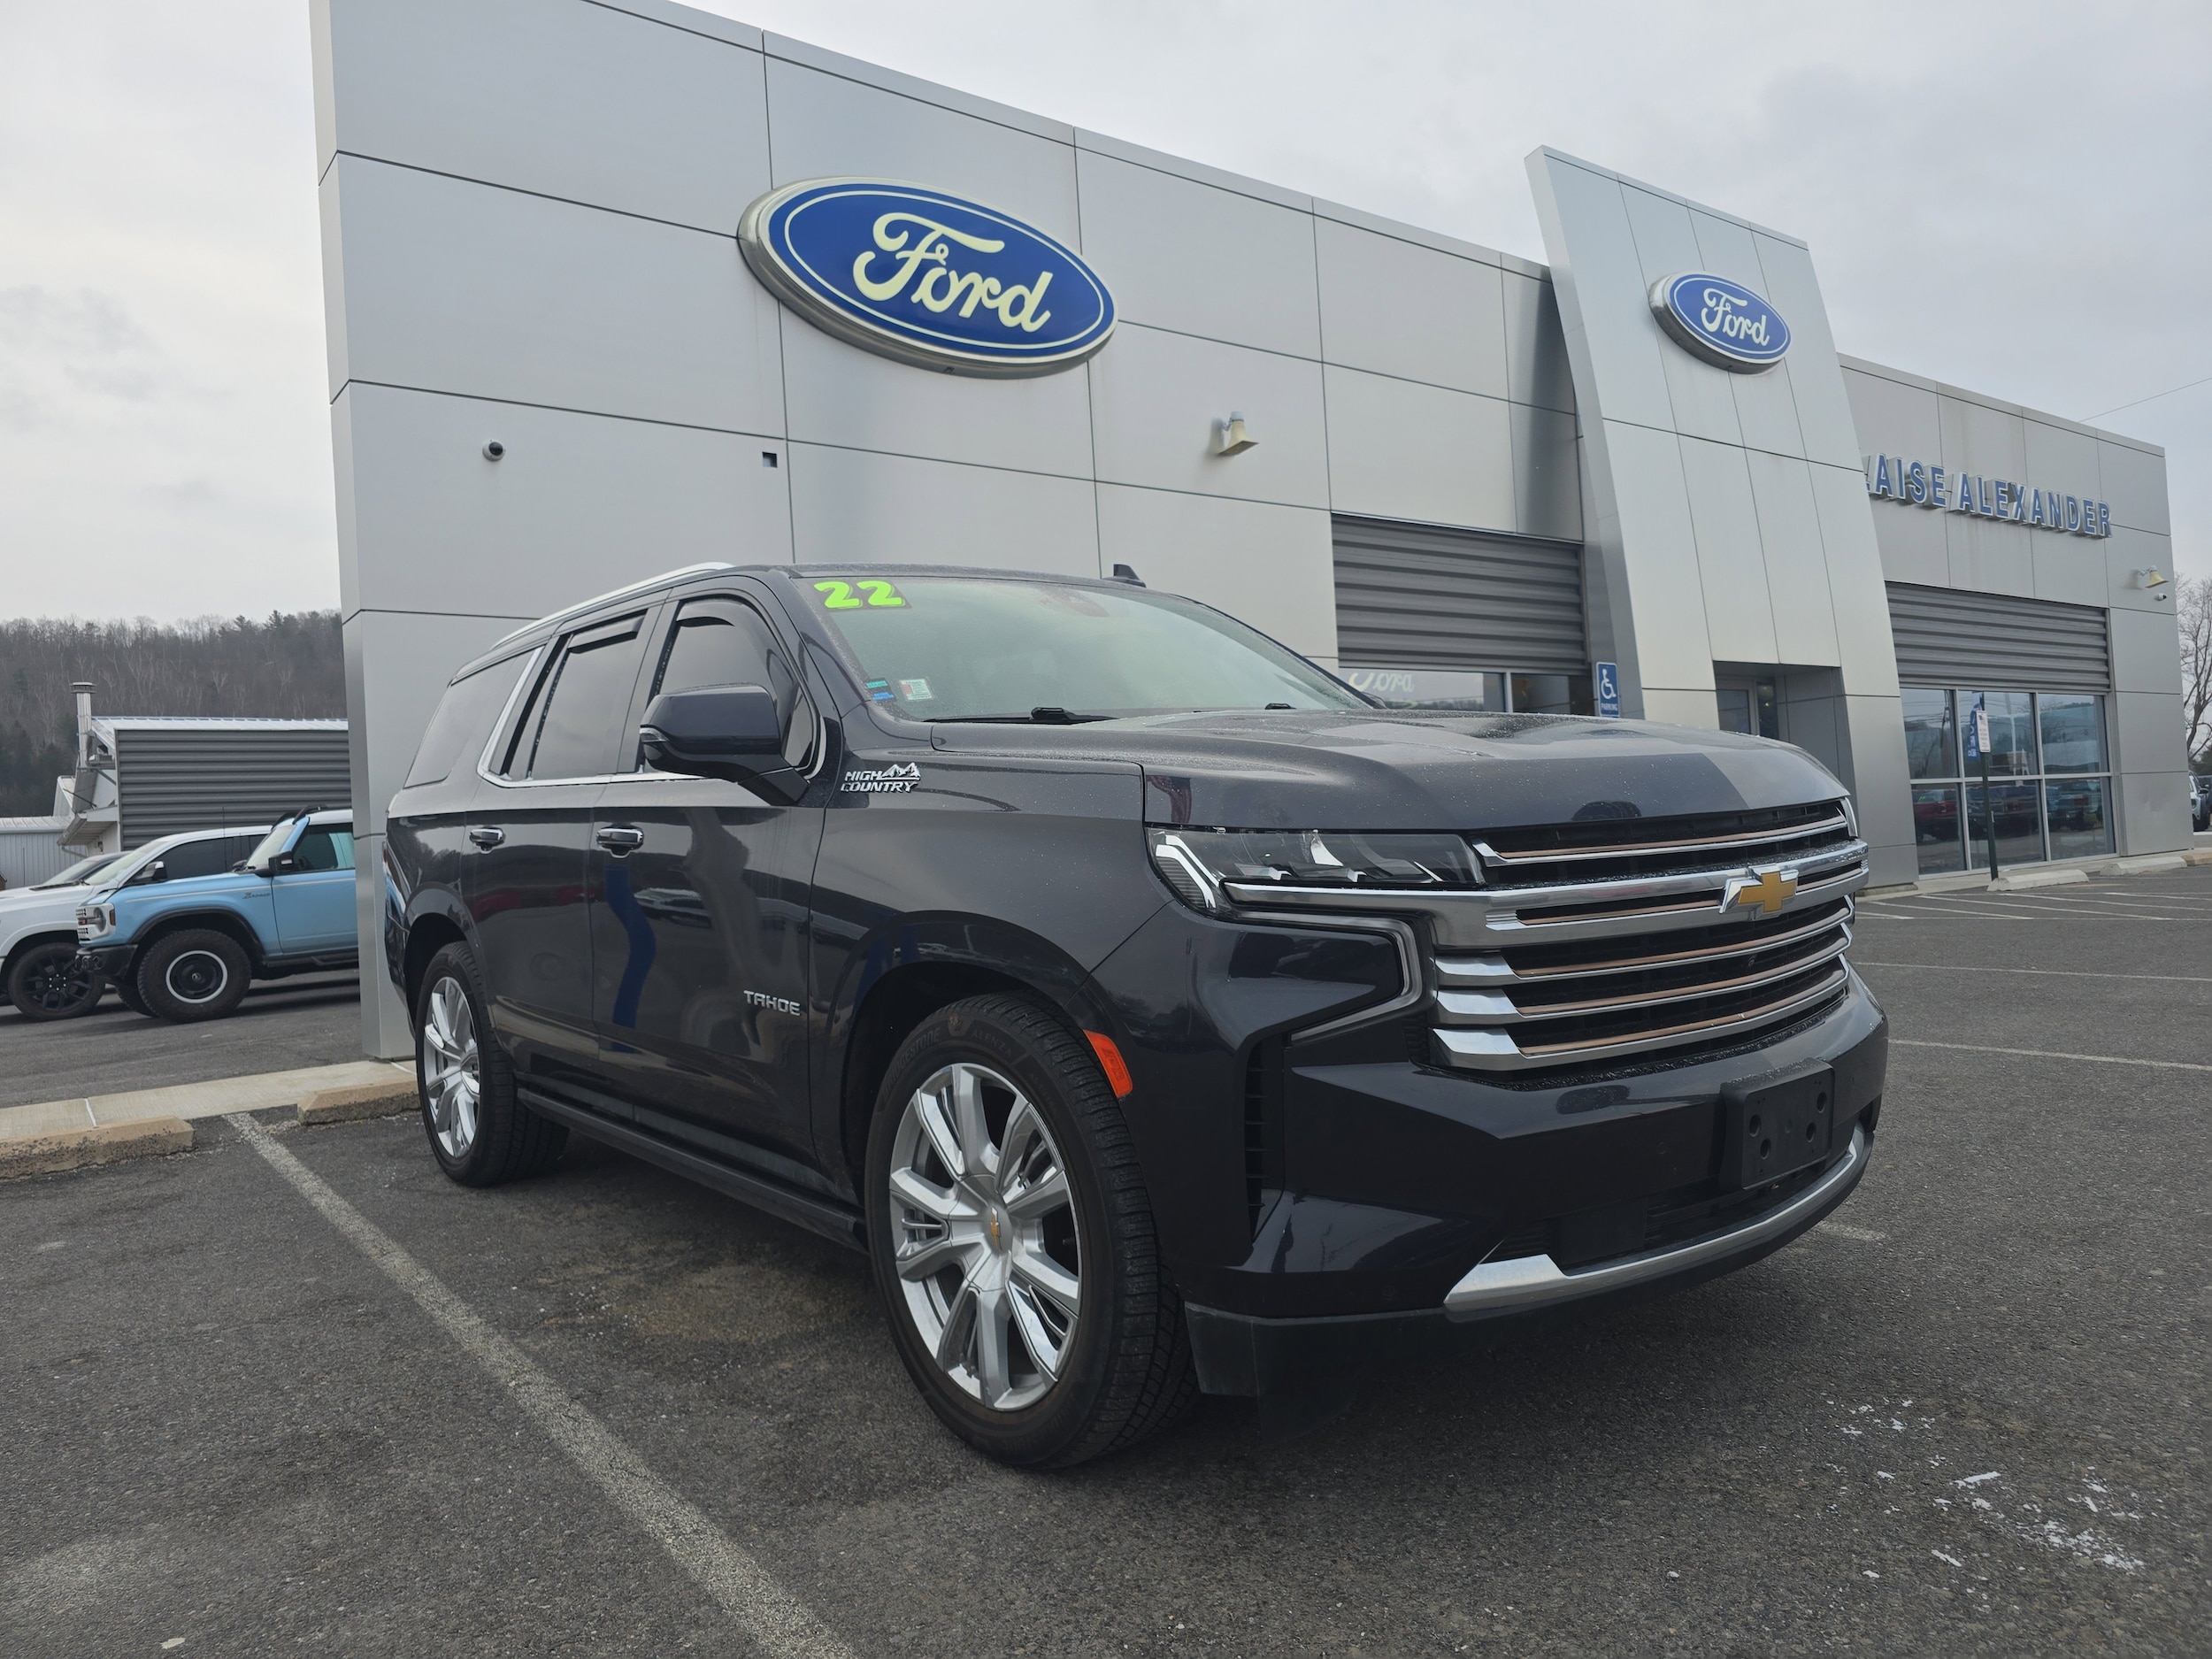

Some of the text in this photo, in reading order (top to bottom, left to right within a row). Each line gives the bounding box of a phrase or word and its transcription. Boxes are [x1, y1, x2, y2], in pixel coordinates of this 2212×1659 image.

[853, 212, 1053, 333] Ford
[1701, 288, 1770, 346] Ford
[1866, 453, 2112, 538] AISE ALEXANDER
[813, 580, 906, 609] 22
[841, 781, 918, 793] COUNTRY
[844, 771, 884, 781] HIGH
[743, 990, 801, 1017] TAHOE
